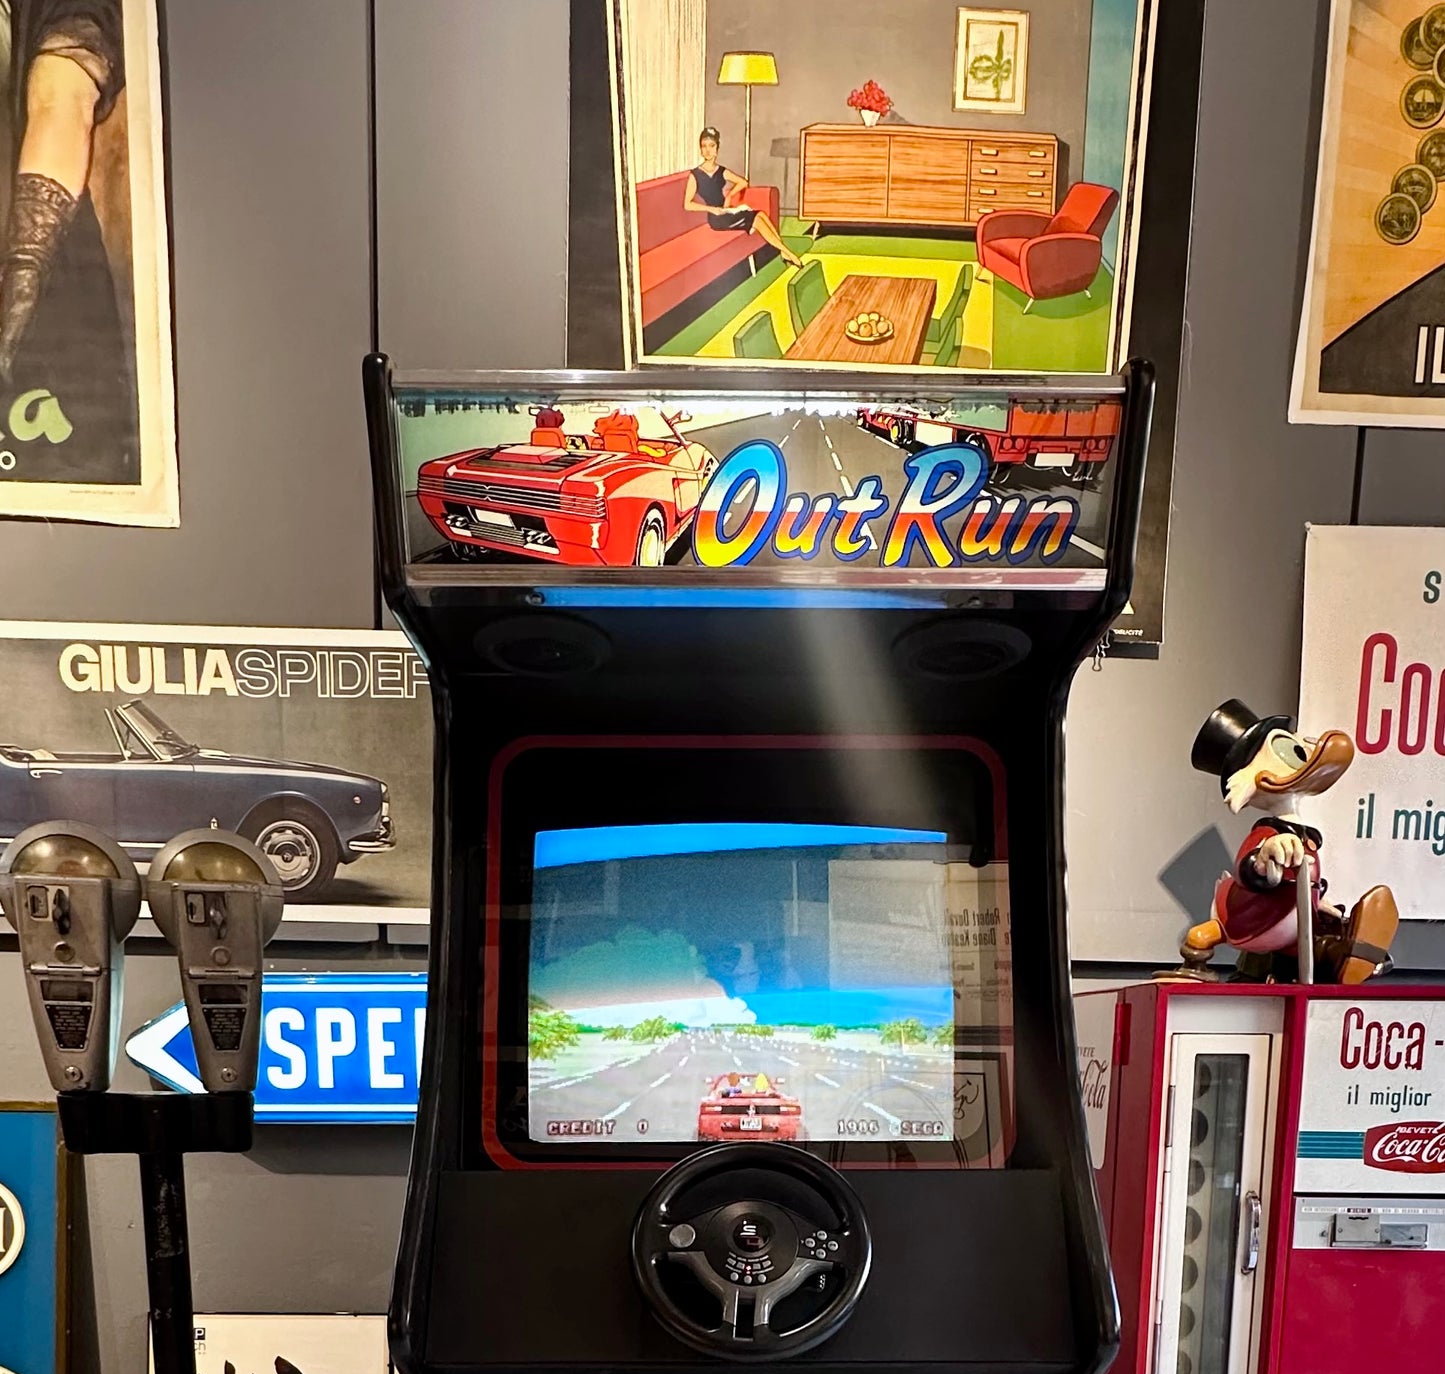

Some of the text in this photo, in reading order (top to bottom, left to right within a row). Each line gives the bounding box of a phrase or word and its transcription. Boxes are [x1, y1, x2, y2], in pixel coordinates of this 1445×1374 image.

[0, 388, 73, 444] a
[1355, 793, 1375, 839] il
[1347, 1084, 1432, 1114] il miglior
[547, 1119, 617, 1136] CREDIT
